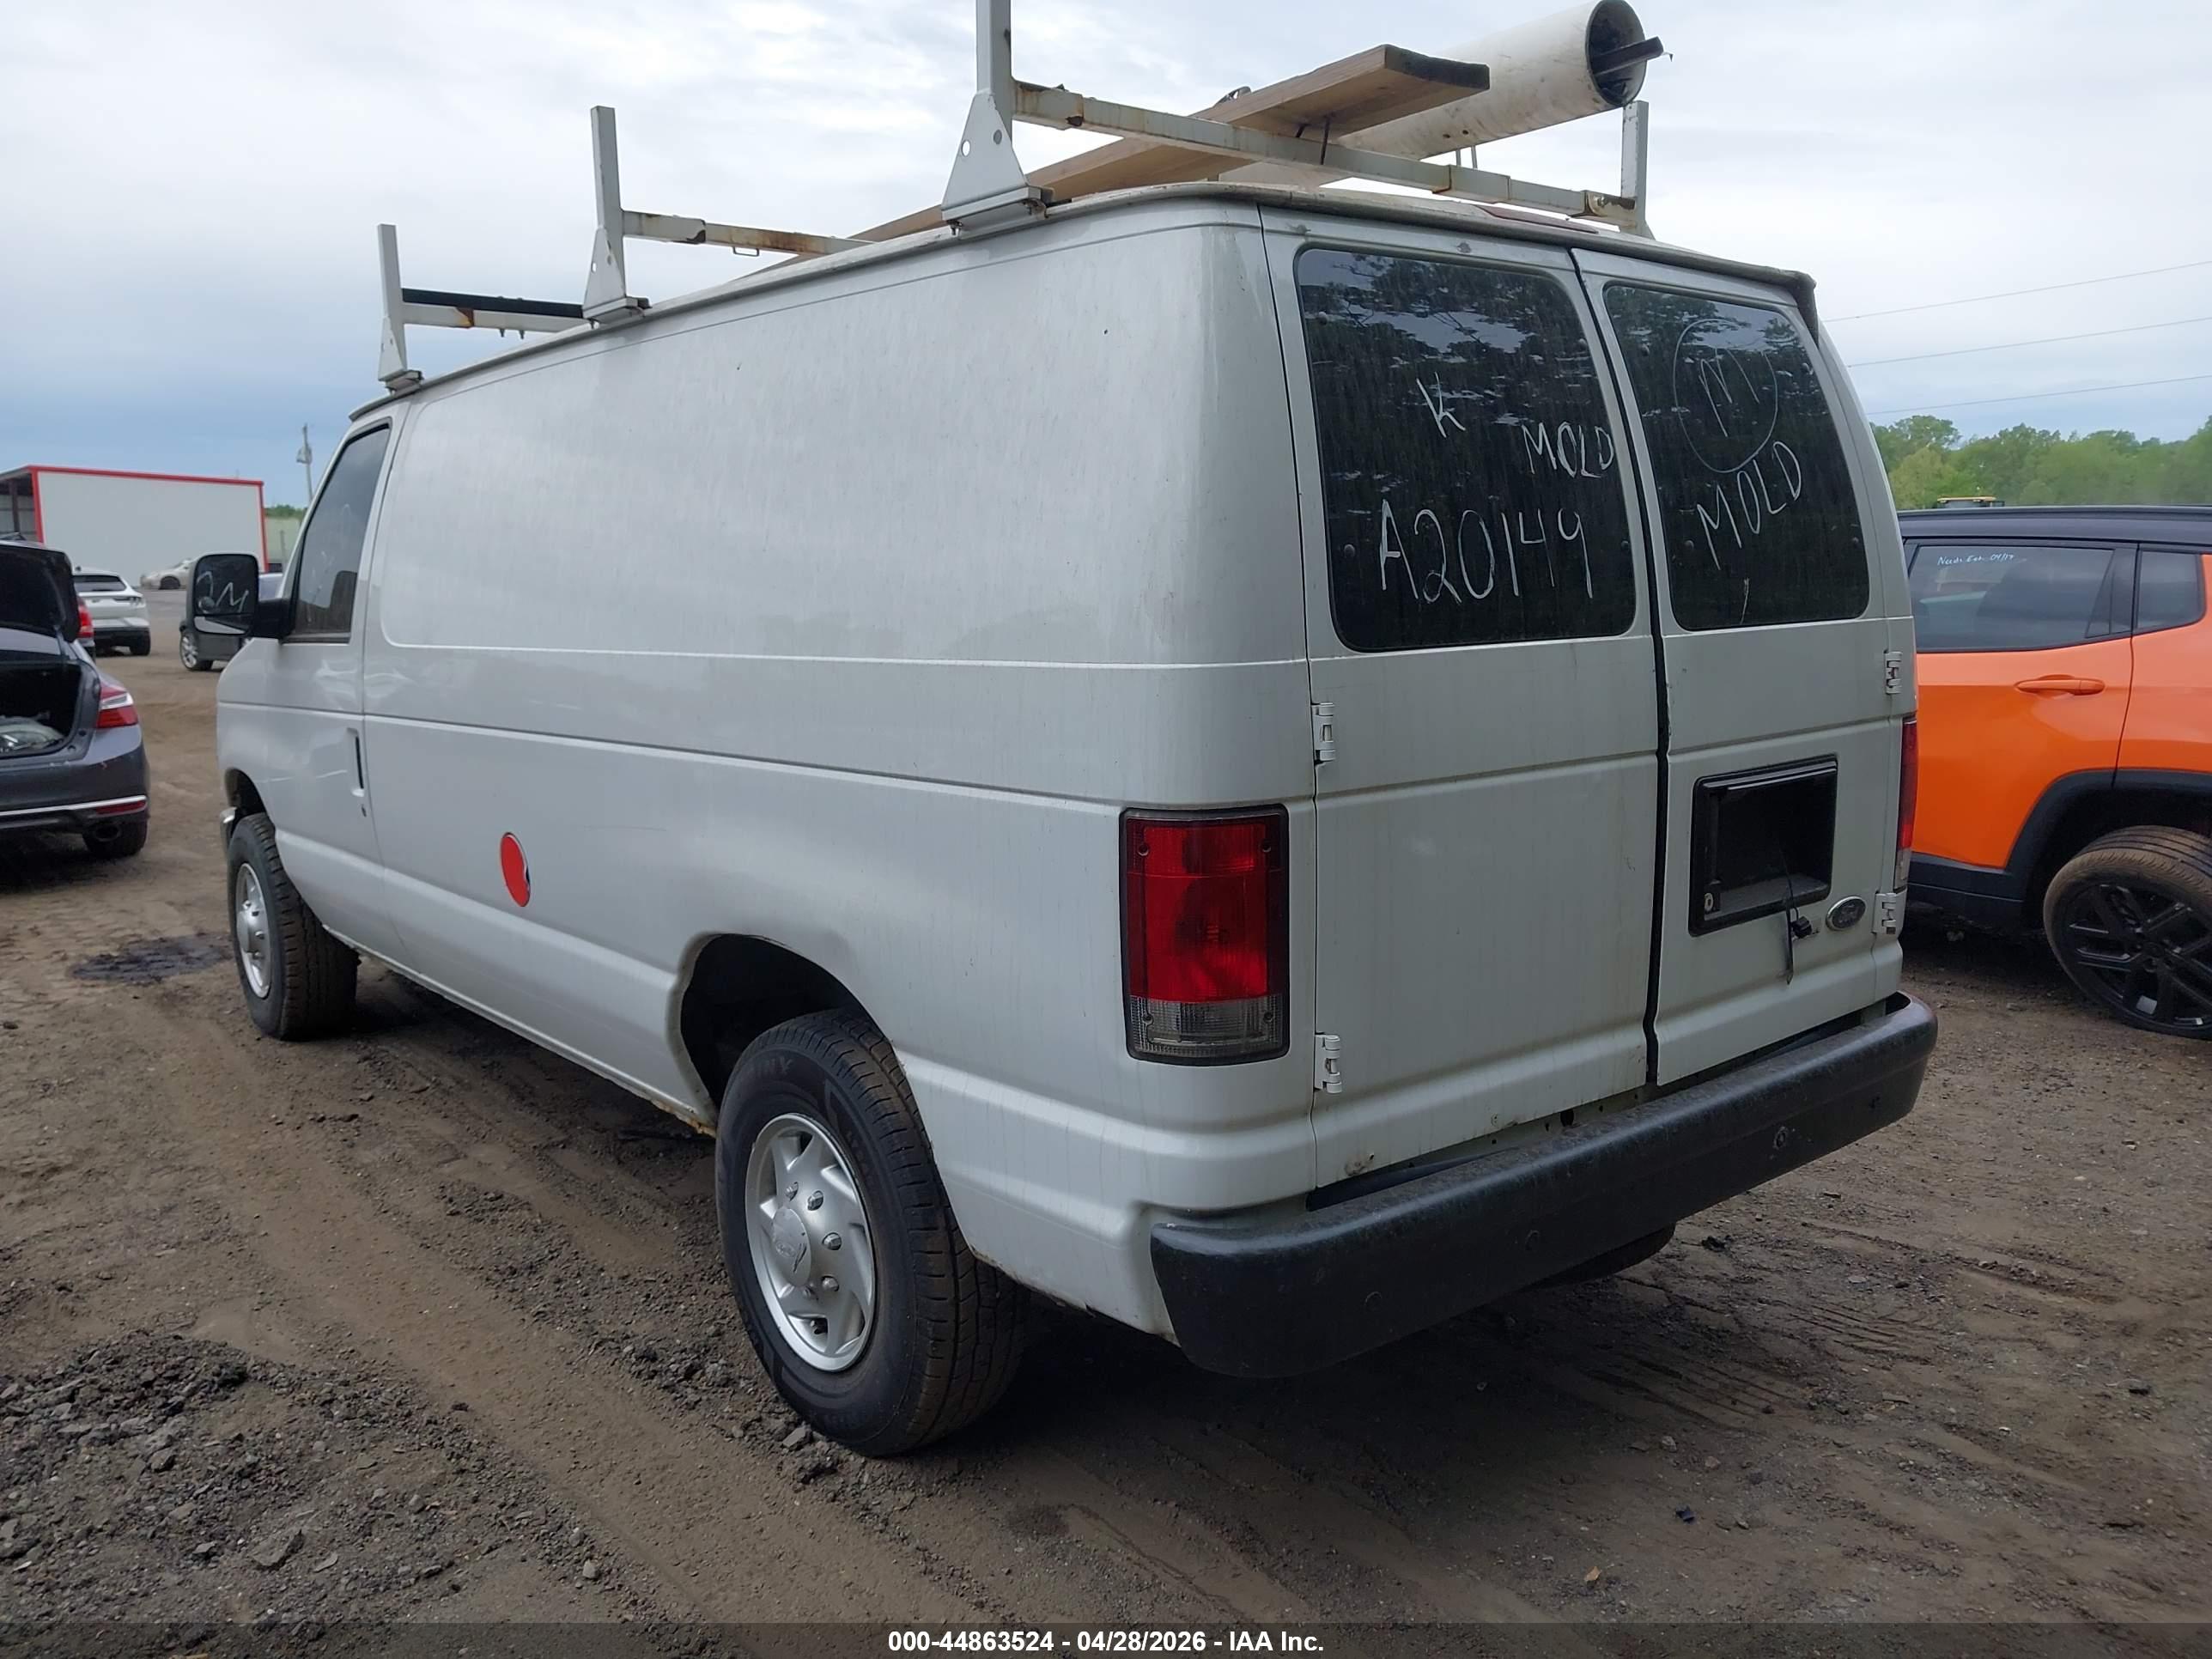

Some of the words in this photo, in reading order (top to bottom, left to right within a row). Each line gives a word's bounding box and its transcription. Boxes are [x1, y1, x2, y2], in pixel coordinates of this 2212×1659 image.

[1415, 371, 1466, 438] K
[1521, 421, 1614, 478] MOLD
[1696, 440, 1802, 571] MOLD
